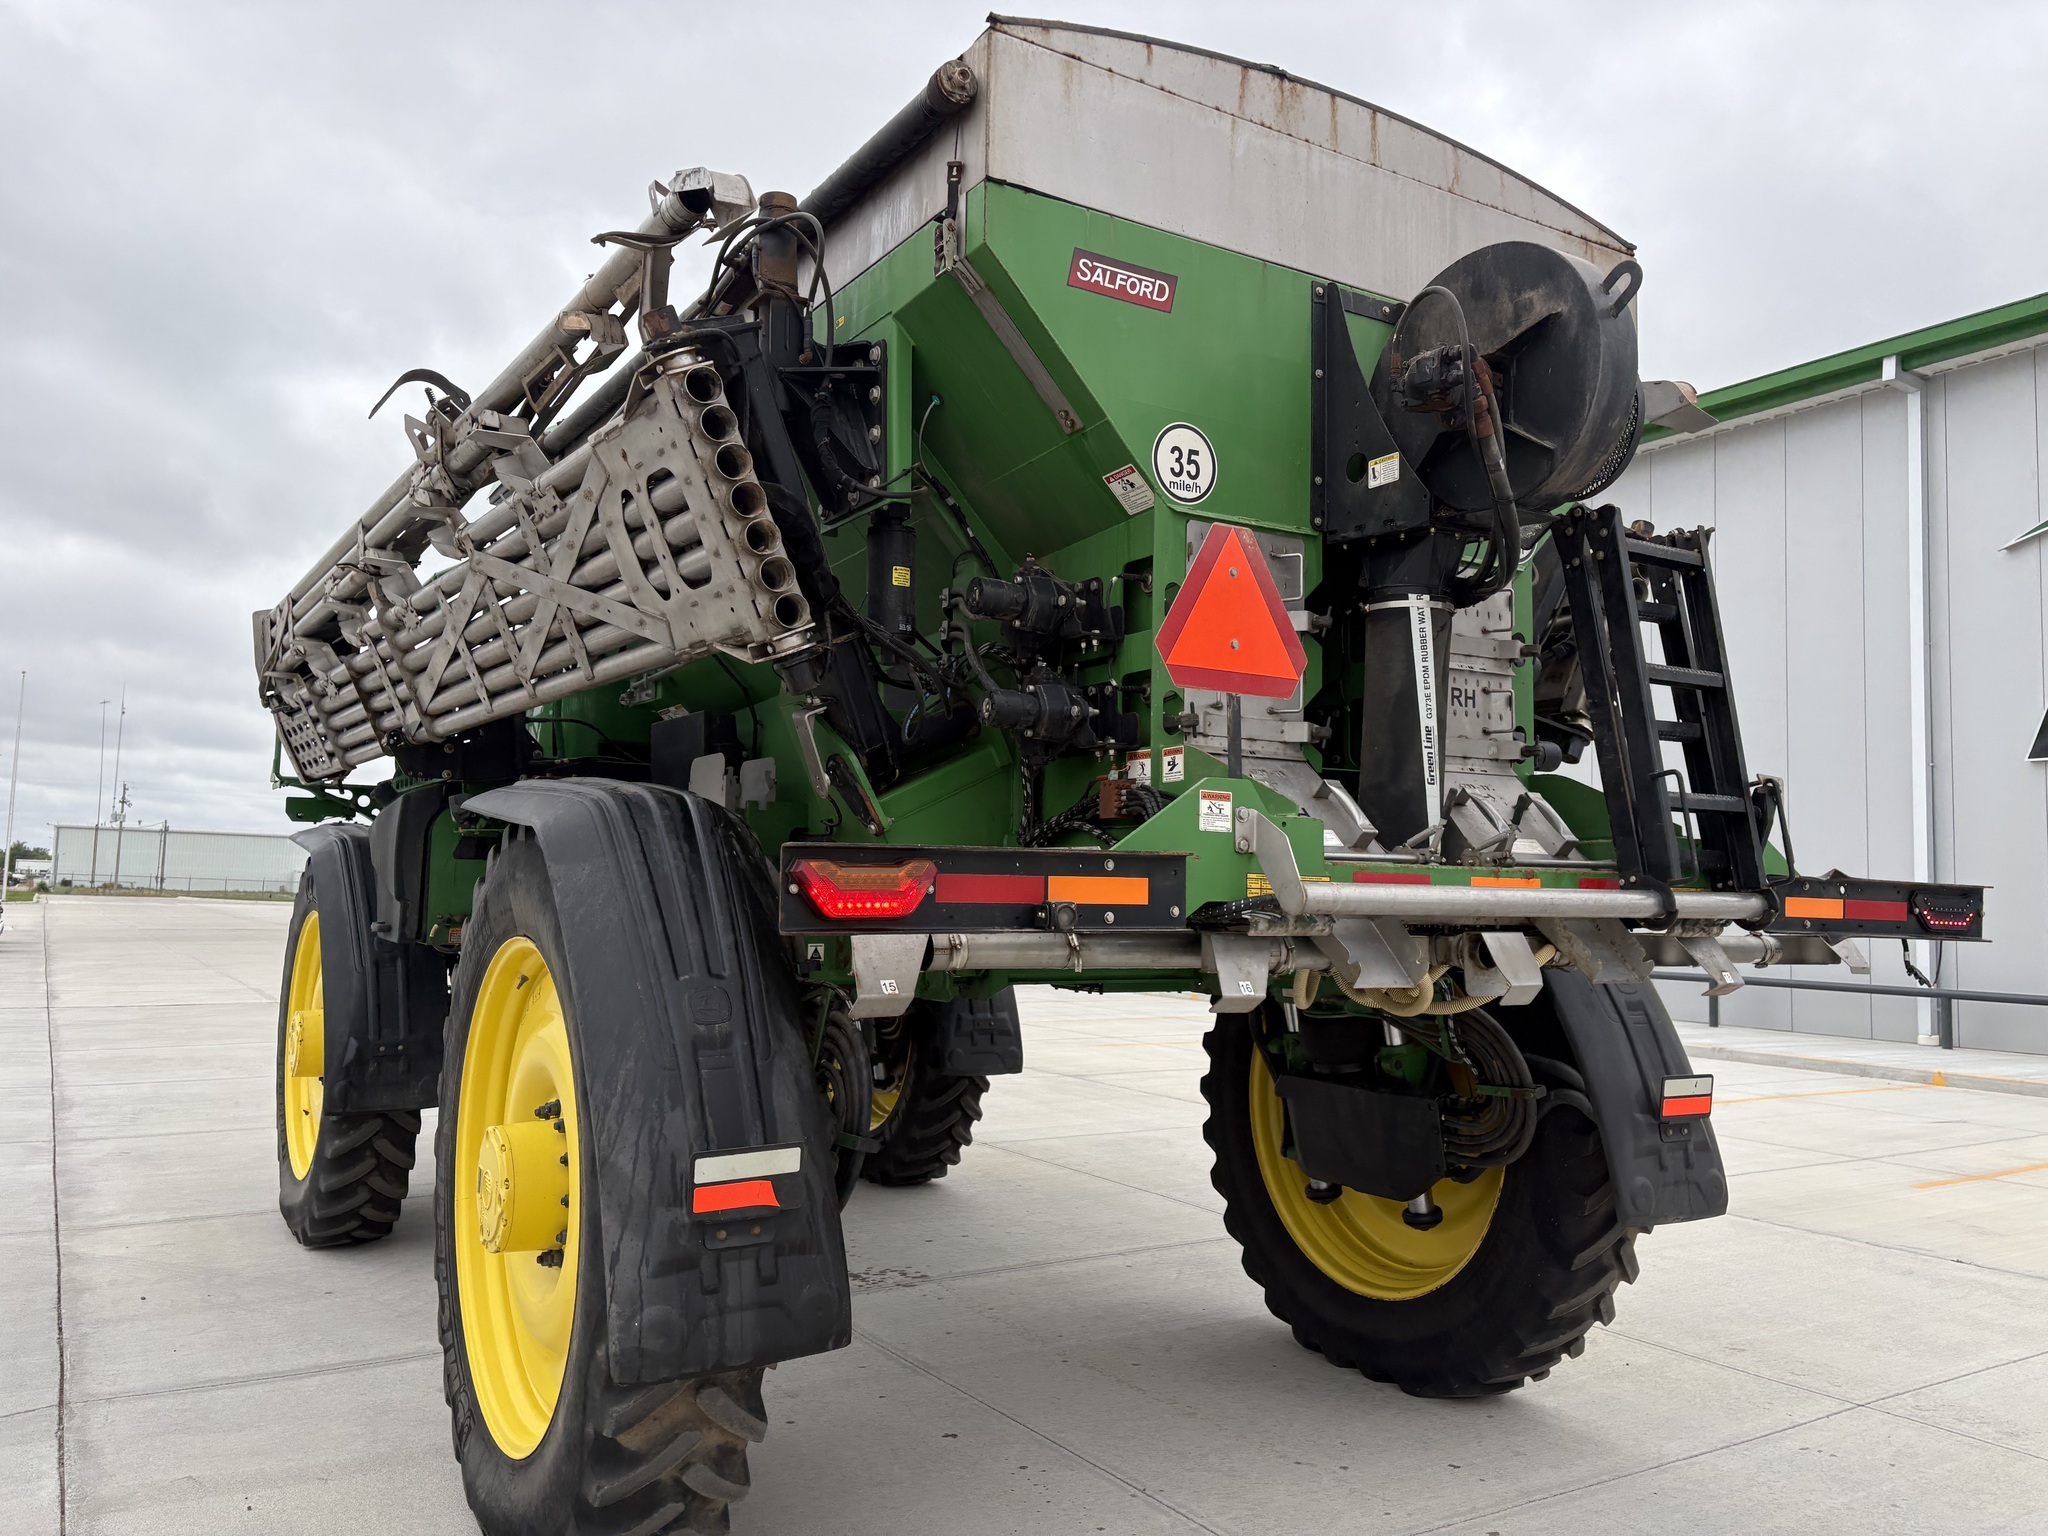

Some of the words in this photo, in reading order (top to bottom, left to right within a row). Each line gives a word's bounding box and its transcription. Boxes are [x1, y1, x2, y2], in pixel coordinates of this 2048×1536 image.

[1076, 258, 1170, 302] SALFORD
[1112, 467, 1133, 480] DANGER
[1170, 445, 1201, 480] 35
[1169, 480, 1202, 493] mile/h
[1416, 594, 1426, 625] WATR
[1419, 626, 1429, 663] RUBBER
[1422, 665, 1431, 690] EPDM
[1424, 692, 1433, 719] G373E
[1451, 687, 1475, 709] RH
[1423, 725, 1433, 749] Line
[1133, 750, 1152, 760] WARNIN
[1426, 751, 1435, 785] Green
[1206, 792, 1231, 802] WARNING
[882, 982, 897, 992] 15
[1241, 984, 1252, 993] 16
